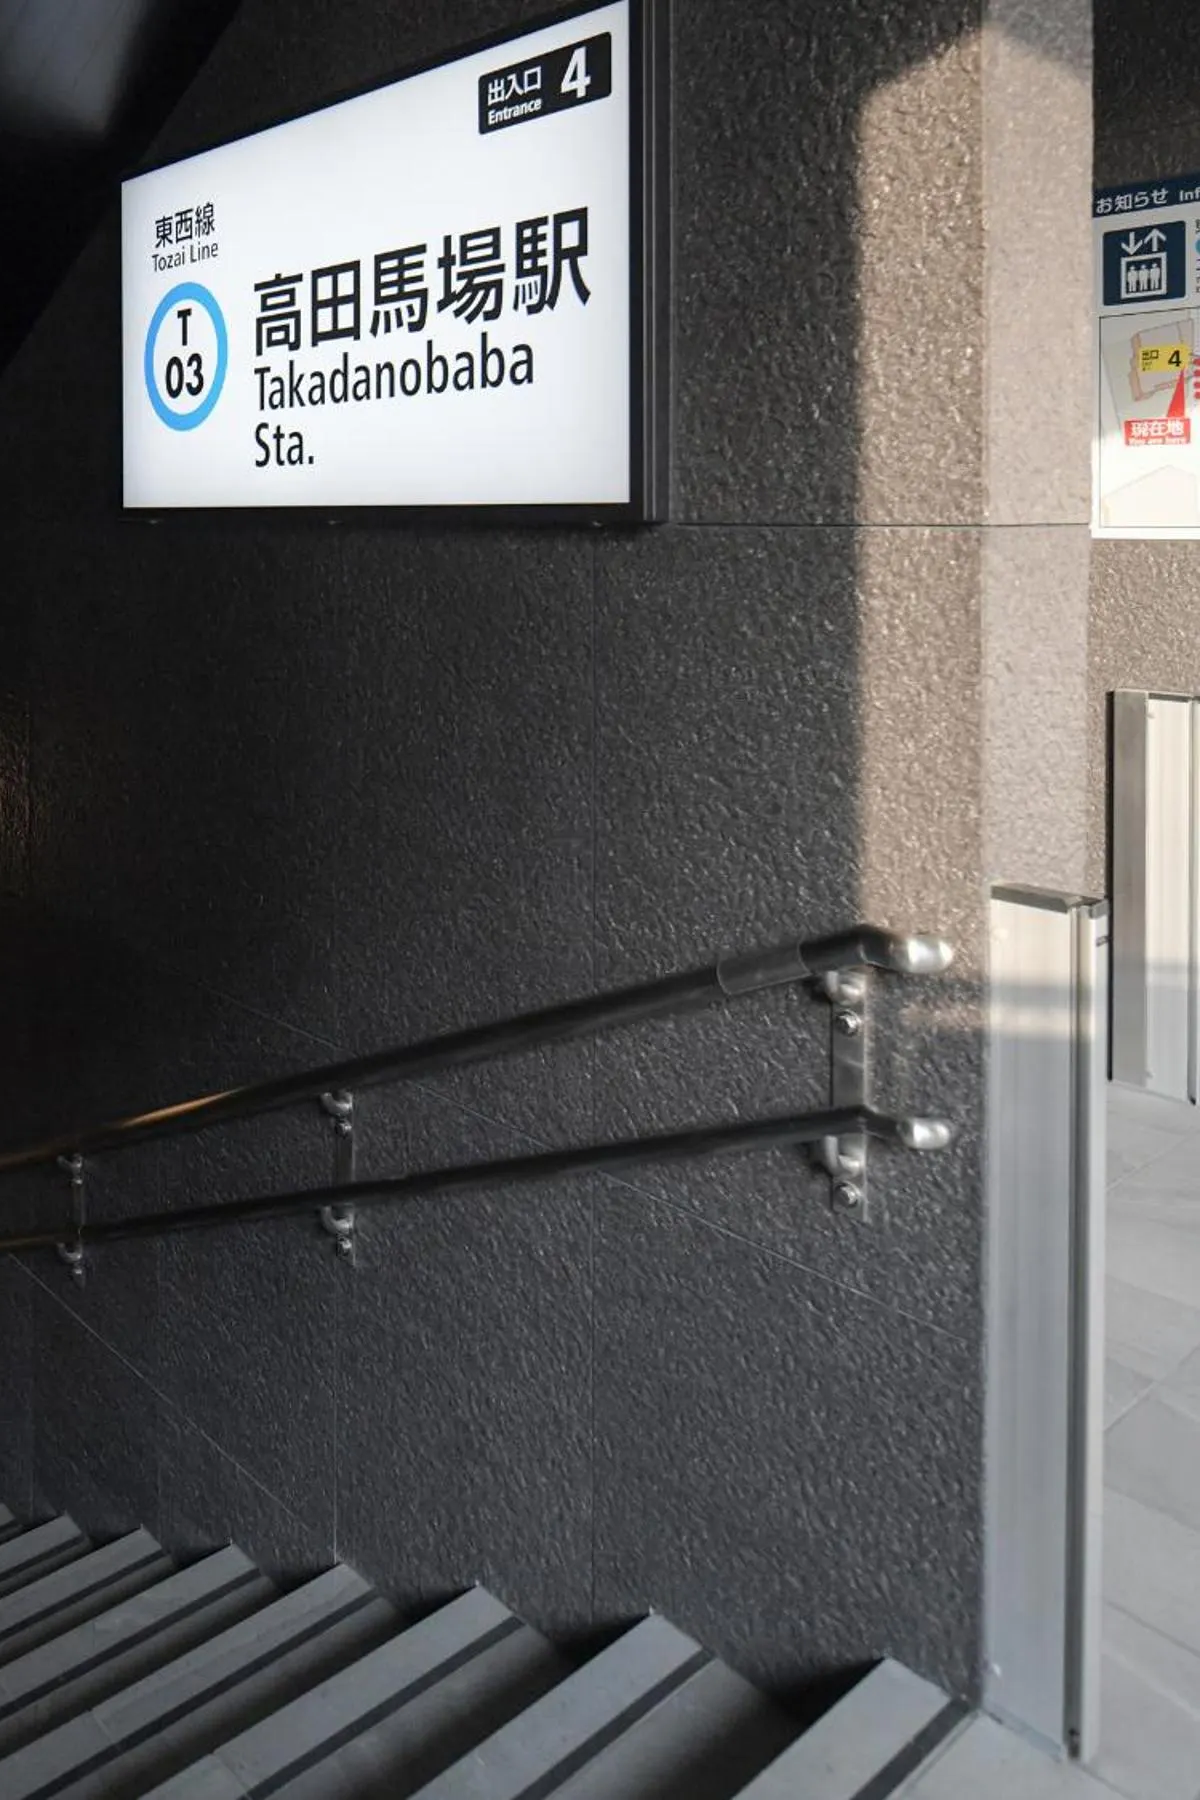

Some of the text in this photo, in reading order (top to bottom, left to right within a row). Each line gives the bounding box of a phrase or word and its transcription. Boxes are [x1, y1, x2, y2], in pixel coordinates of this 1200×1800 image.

[487, 46, 591, 106] 出入口 4
[487, 98, 542, 126] Entrance
[1096, 187, 1169, 214] お知らせ
[154, 202, 216, 249] 東西線
[151, 241, 219, 272] Tozai Line
[253, 206, 592, 357] 高田馬場駅
[177, 308, 192, 347] T
[165, 353, 204, 399] 03
[253, 331, 535, 411] Takadanobaba
[1167, 349, 1182, 367] 4
[254, 421, 315, 468] Sta.
